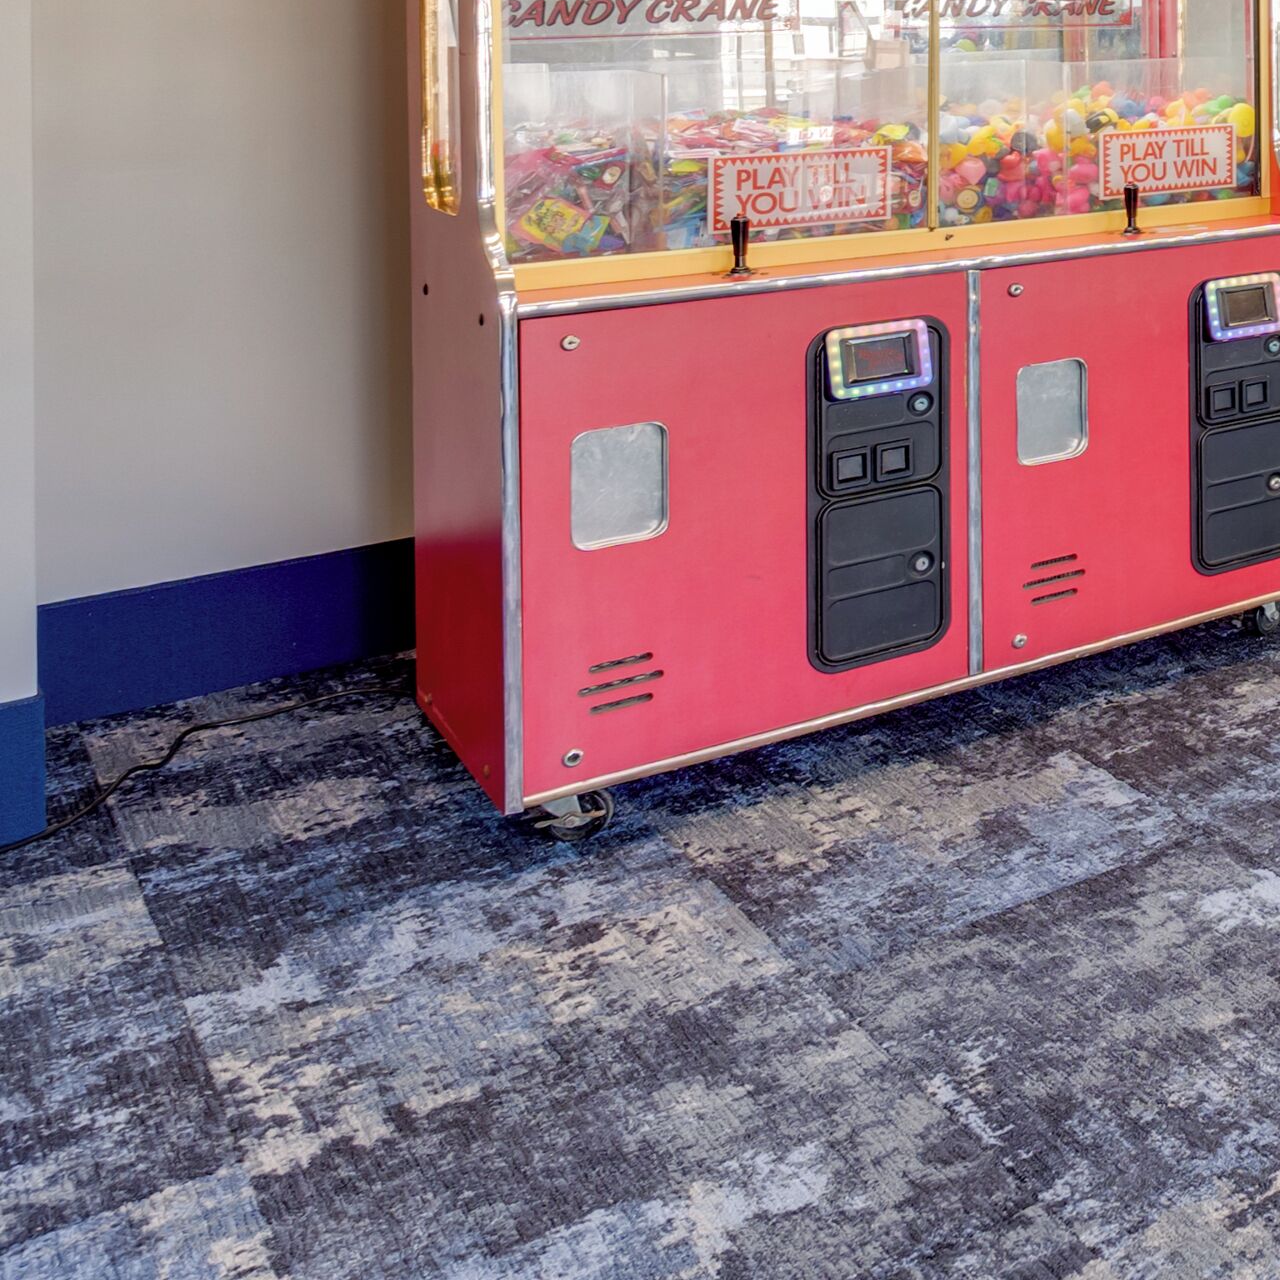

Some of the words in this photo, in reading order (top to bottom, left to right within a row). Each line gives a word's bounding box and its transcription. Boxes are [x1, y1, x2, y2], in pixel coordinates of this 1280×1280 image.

[1119, 139, 1167, 163] PLAY
[1173, 136, 1210, 157] TILL
[736, 166, 799, 191] PLAY
[807, 163, 856, 185] TILL
[1120, 162, 1168, 184] YOU
[1174, 156, 1218, 178] WIN
[736, 190, 799, 216] YOU
[808, 185, 866, 211] WIN
